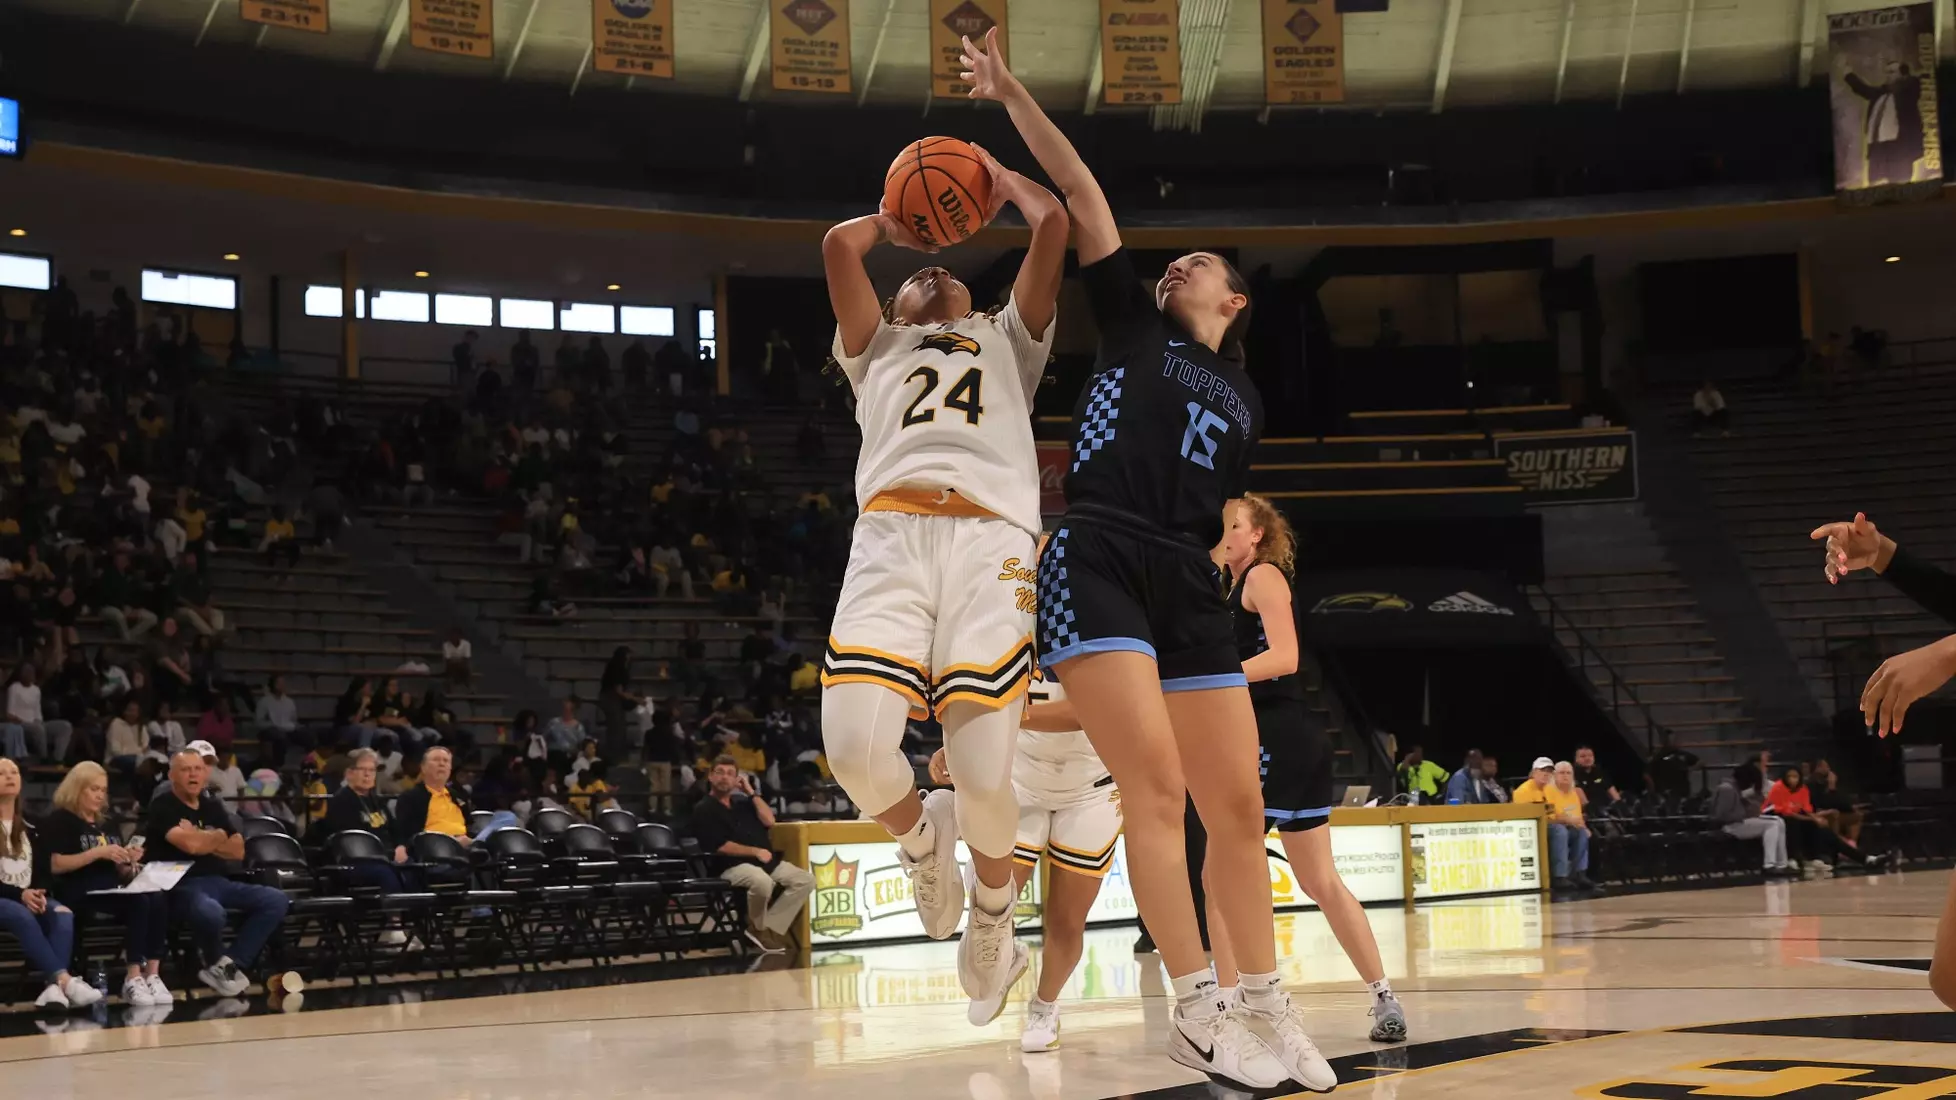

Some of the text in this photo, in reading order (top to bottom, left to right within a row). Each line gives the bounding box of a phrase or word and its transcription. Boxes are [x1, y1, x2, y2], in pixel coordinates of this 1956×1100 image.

[1273, 46, 1335, 55] GOLDEN
[1275, 58, 1335, 68] EAGLES
[901, 366, 984, 431] 24
[1181, 401, 1229, 470] 15
[1507, 445, 1627, 472] SOUTHERN
[1540, 470, 1587, 490] MISS
[1428, 603, 1514, 615] adidas
[1429, 840, 1487, 862] SOUTHERN
[1489, 839, 1515, 859] MISS
[1431, 860, 1517, 893] GAMEDAY APP
[873, 876, 904, 906] KEG
